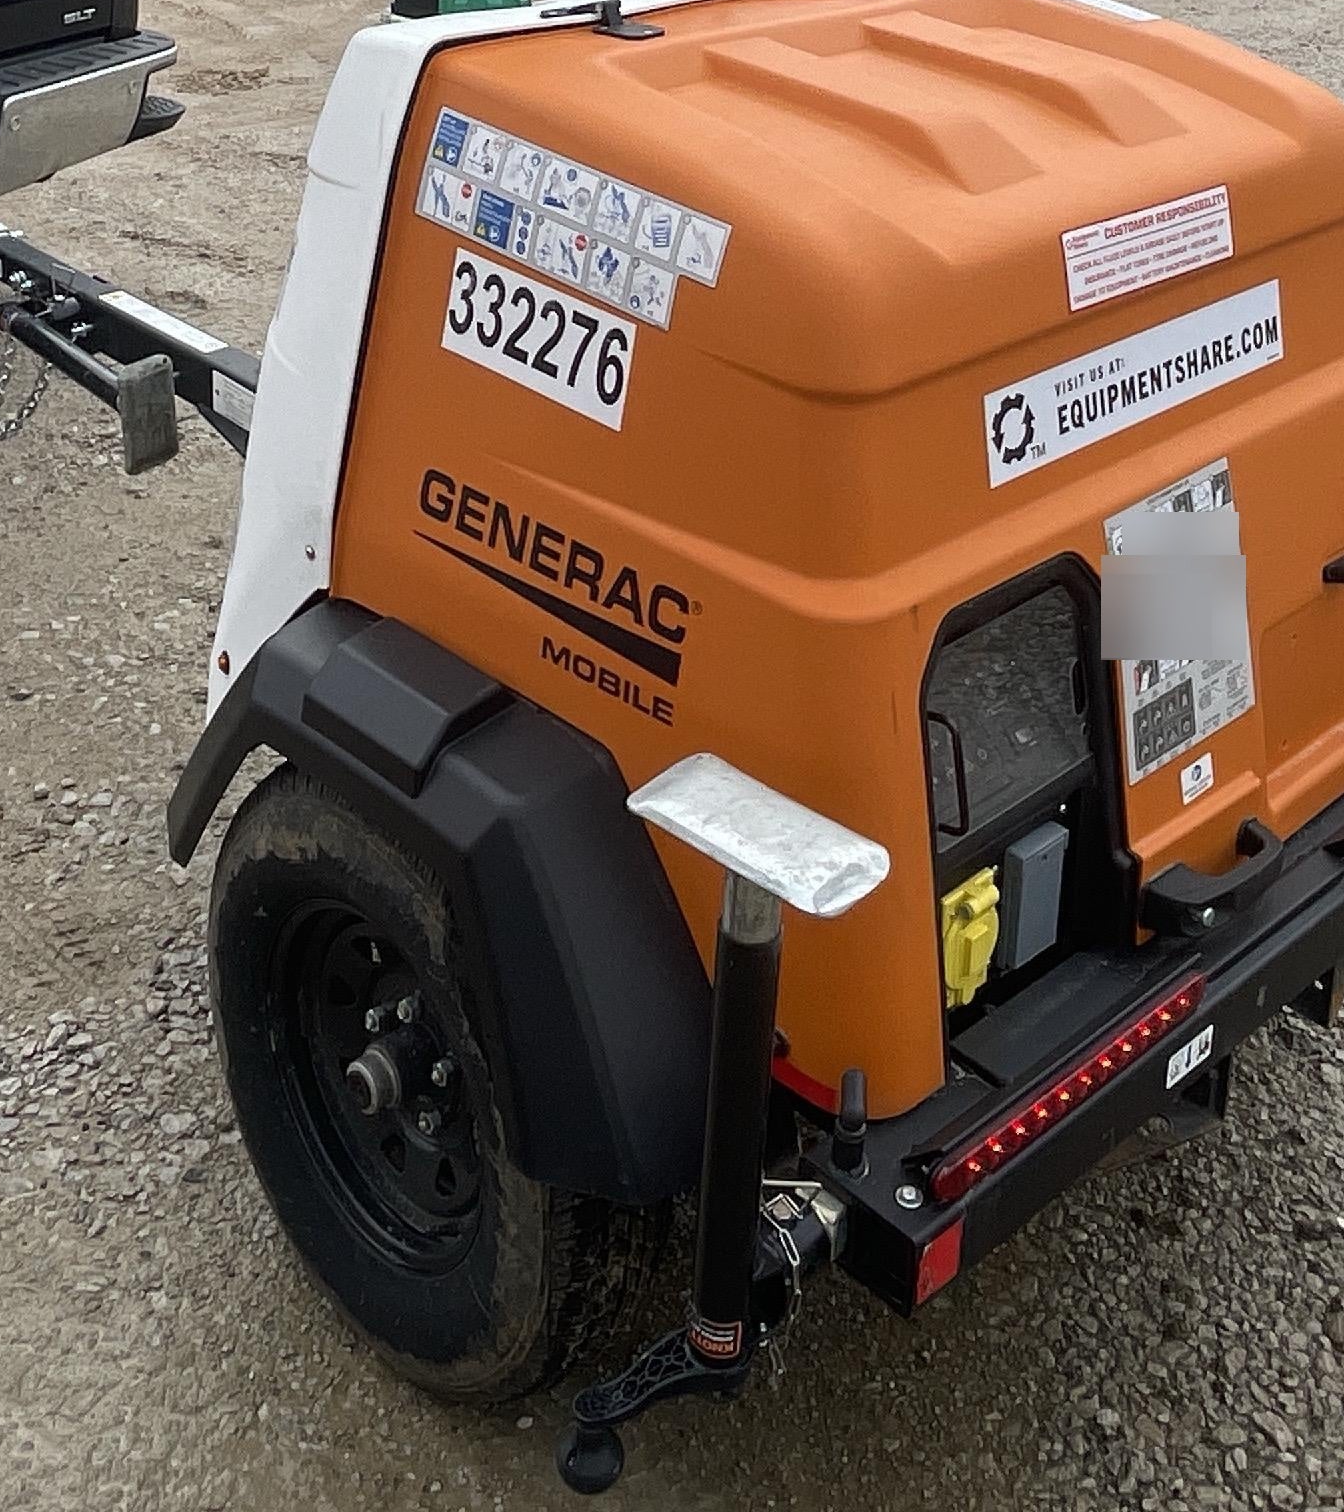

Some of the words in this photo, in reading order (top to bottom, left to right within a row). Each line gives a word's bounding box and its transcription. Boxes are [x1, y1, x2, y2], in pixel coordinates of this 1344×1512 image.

[63, 8, 96, 24] SLT
[1104, 214, 1154, 240] CUSTOMER
[1156, 192, 1226, 224] RESPONSIBILITY
[449, 261, 628, 406] 332276
[1057, 315, 1279, 436] EQUIPMENTSHARE.COM
[1054, 373, 1084, 397] VISIT
[1089, 367, 1105, 385] US
[420, 468, 690, 645] GENERAC
[540, 636, 675, 728] MOBILE
